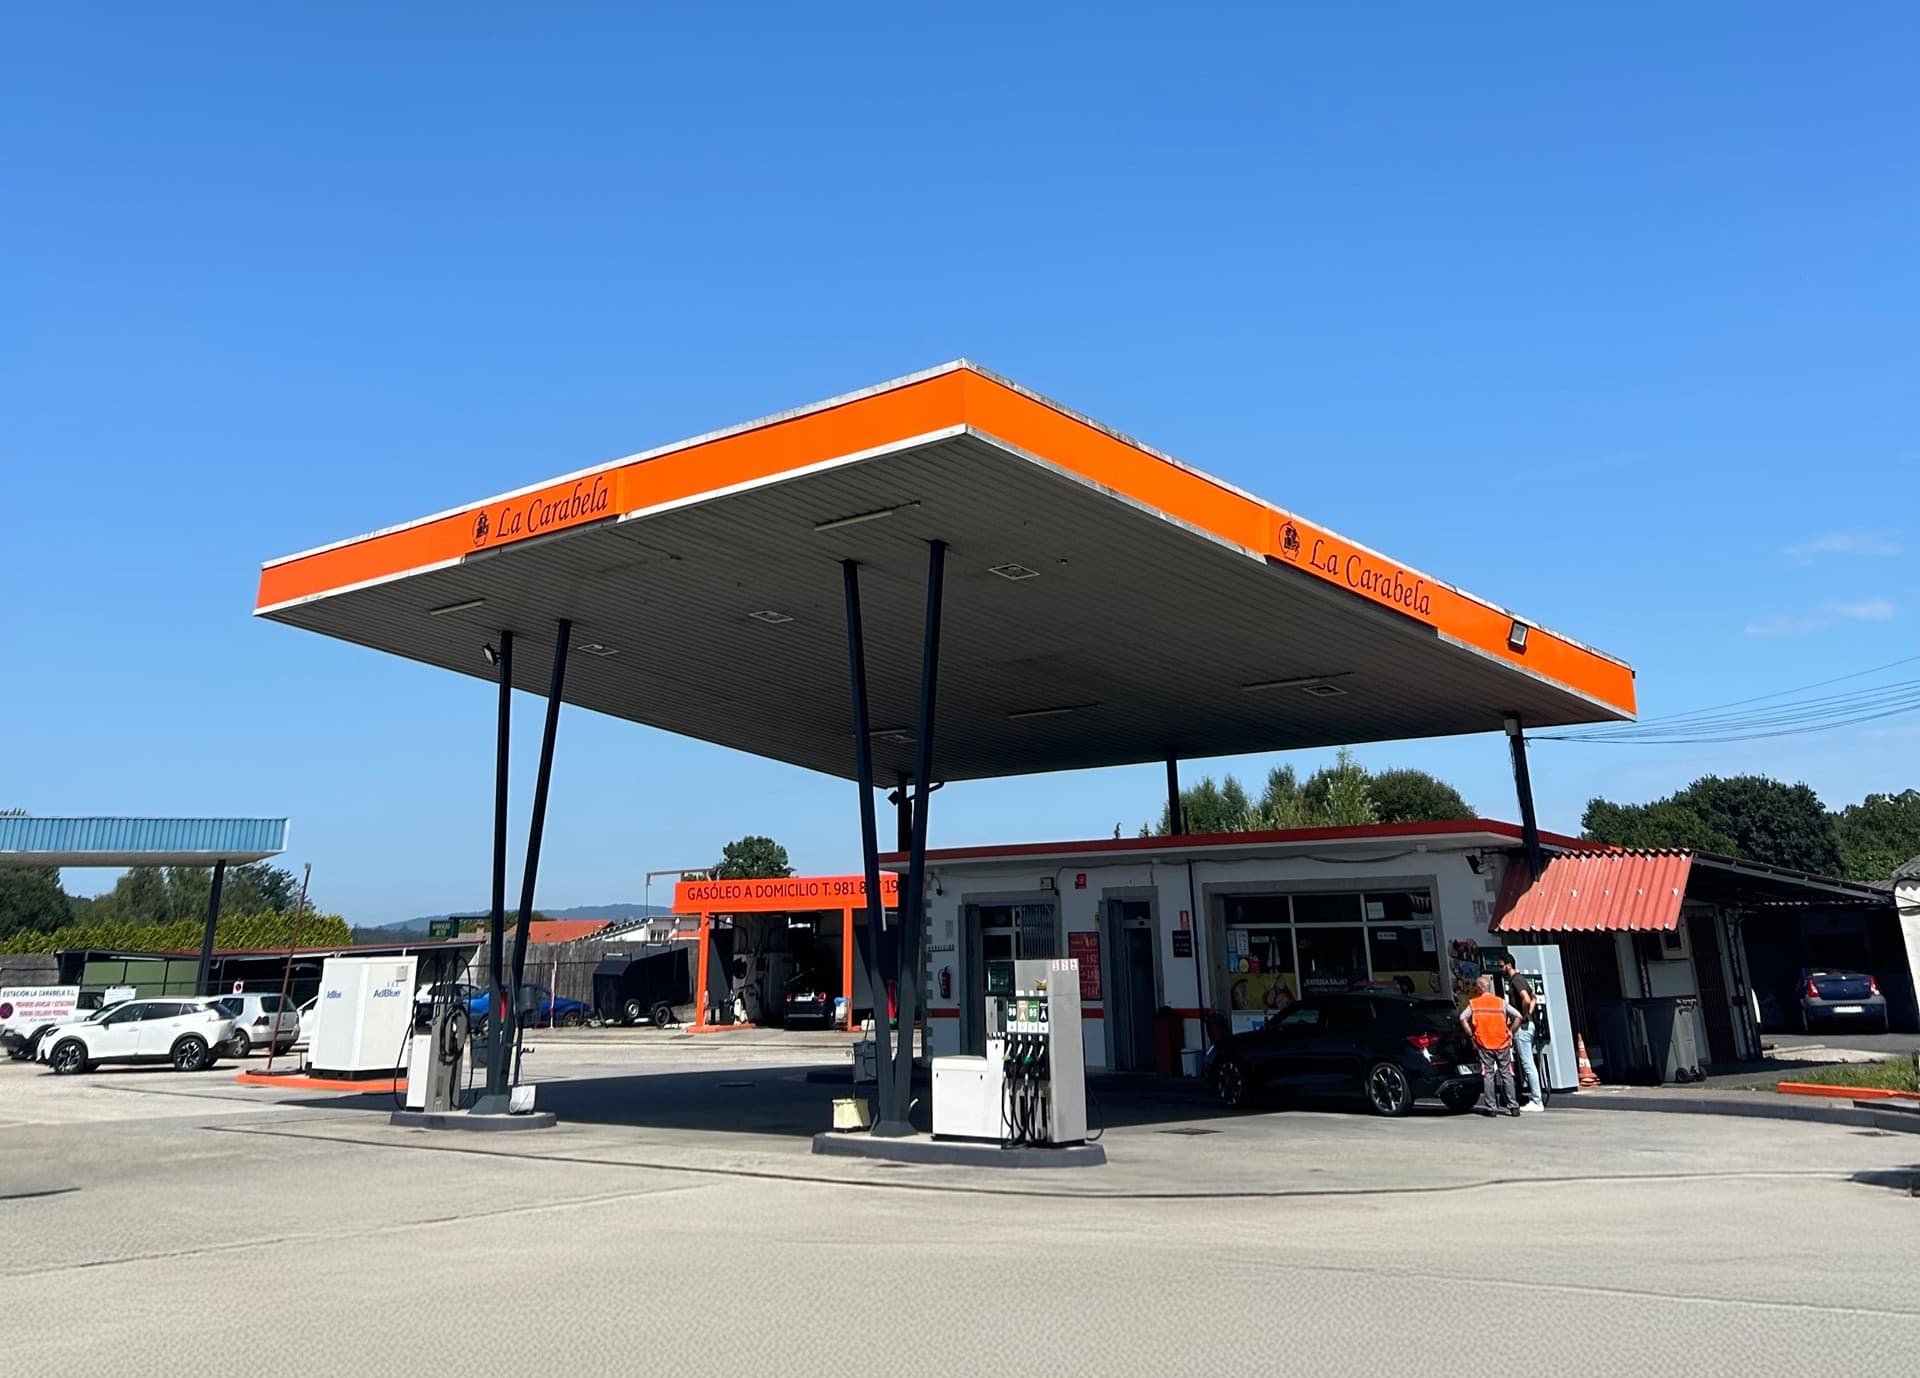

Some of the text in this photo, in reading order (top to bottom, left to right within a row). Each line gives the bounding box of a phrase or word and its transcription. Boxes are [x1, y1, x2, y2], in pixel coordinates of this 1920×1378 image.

[496, 477, 608, 538] La Carabela
[1309, 539, 1431, 615] La Carabela
[687, 883, 741, 900] GASÓLEO
[744, 885, 753, 898] A
[755, 882, 819, 898] DOMICILIO
[373, 989, 400, 998] AdBlue
